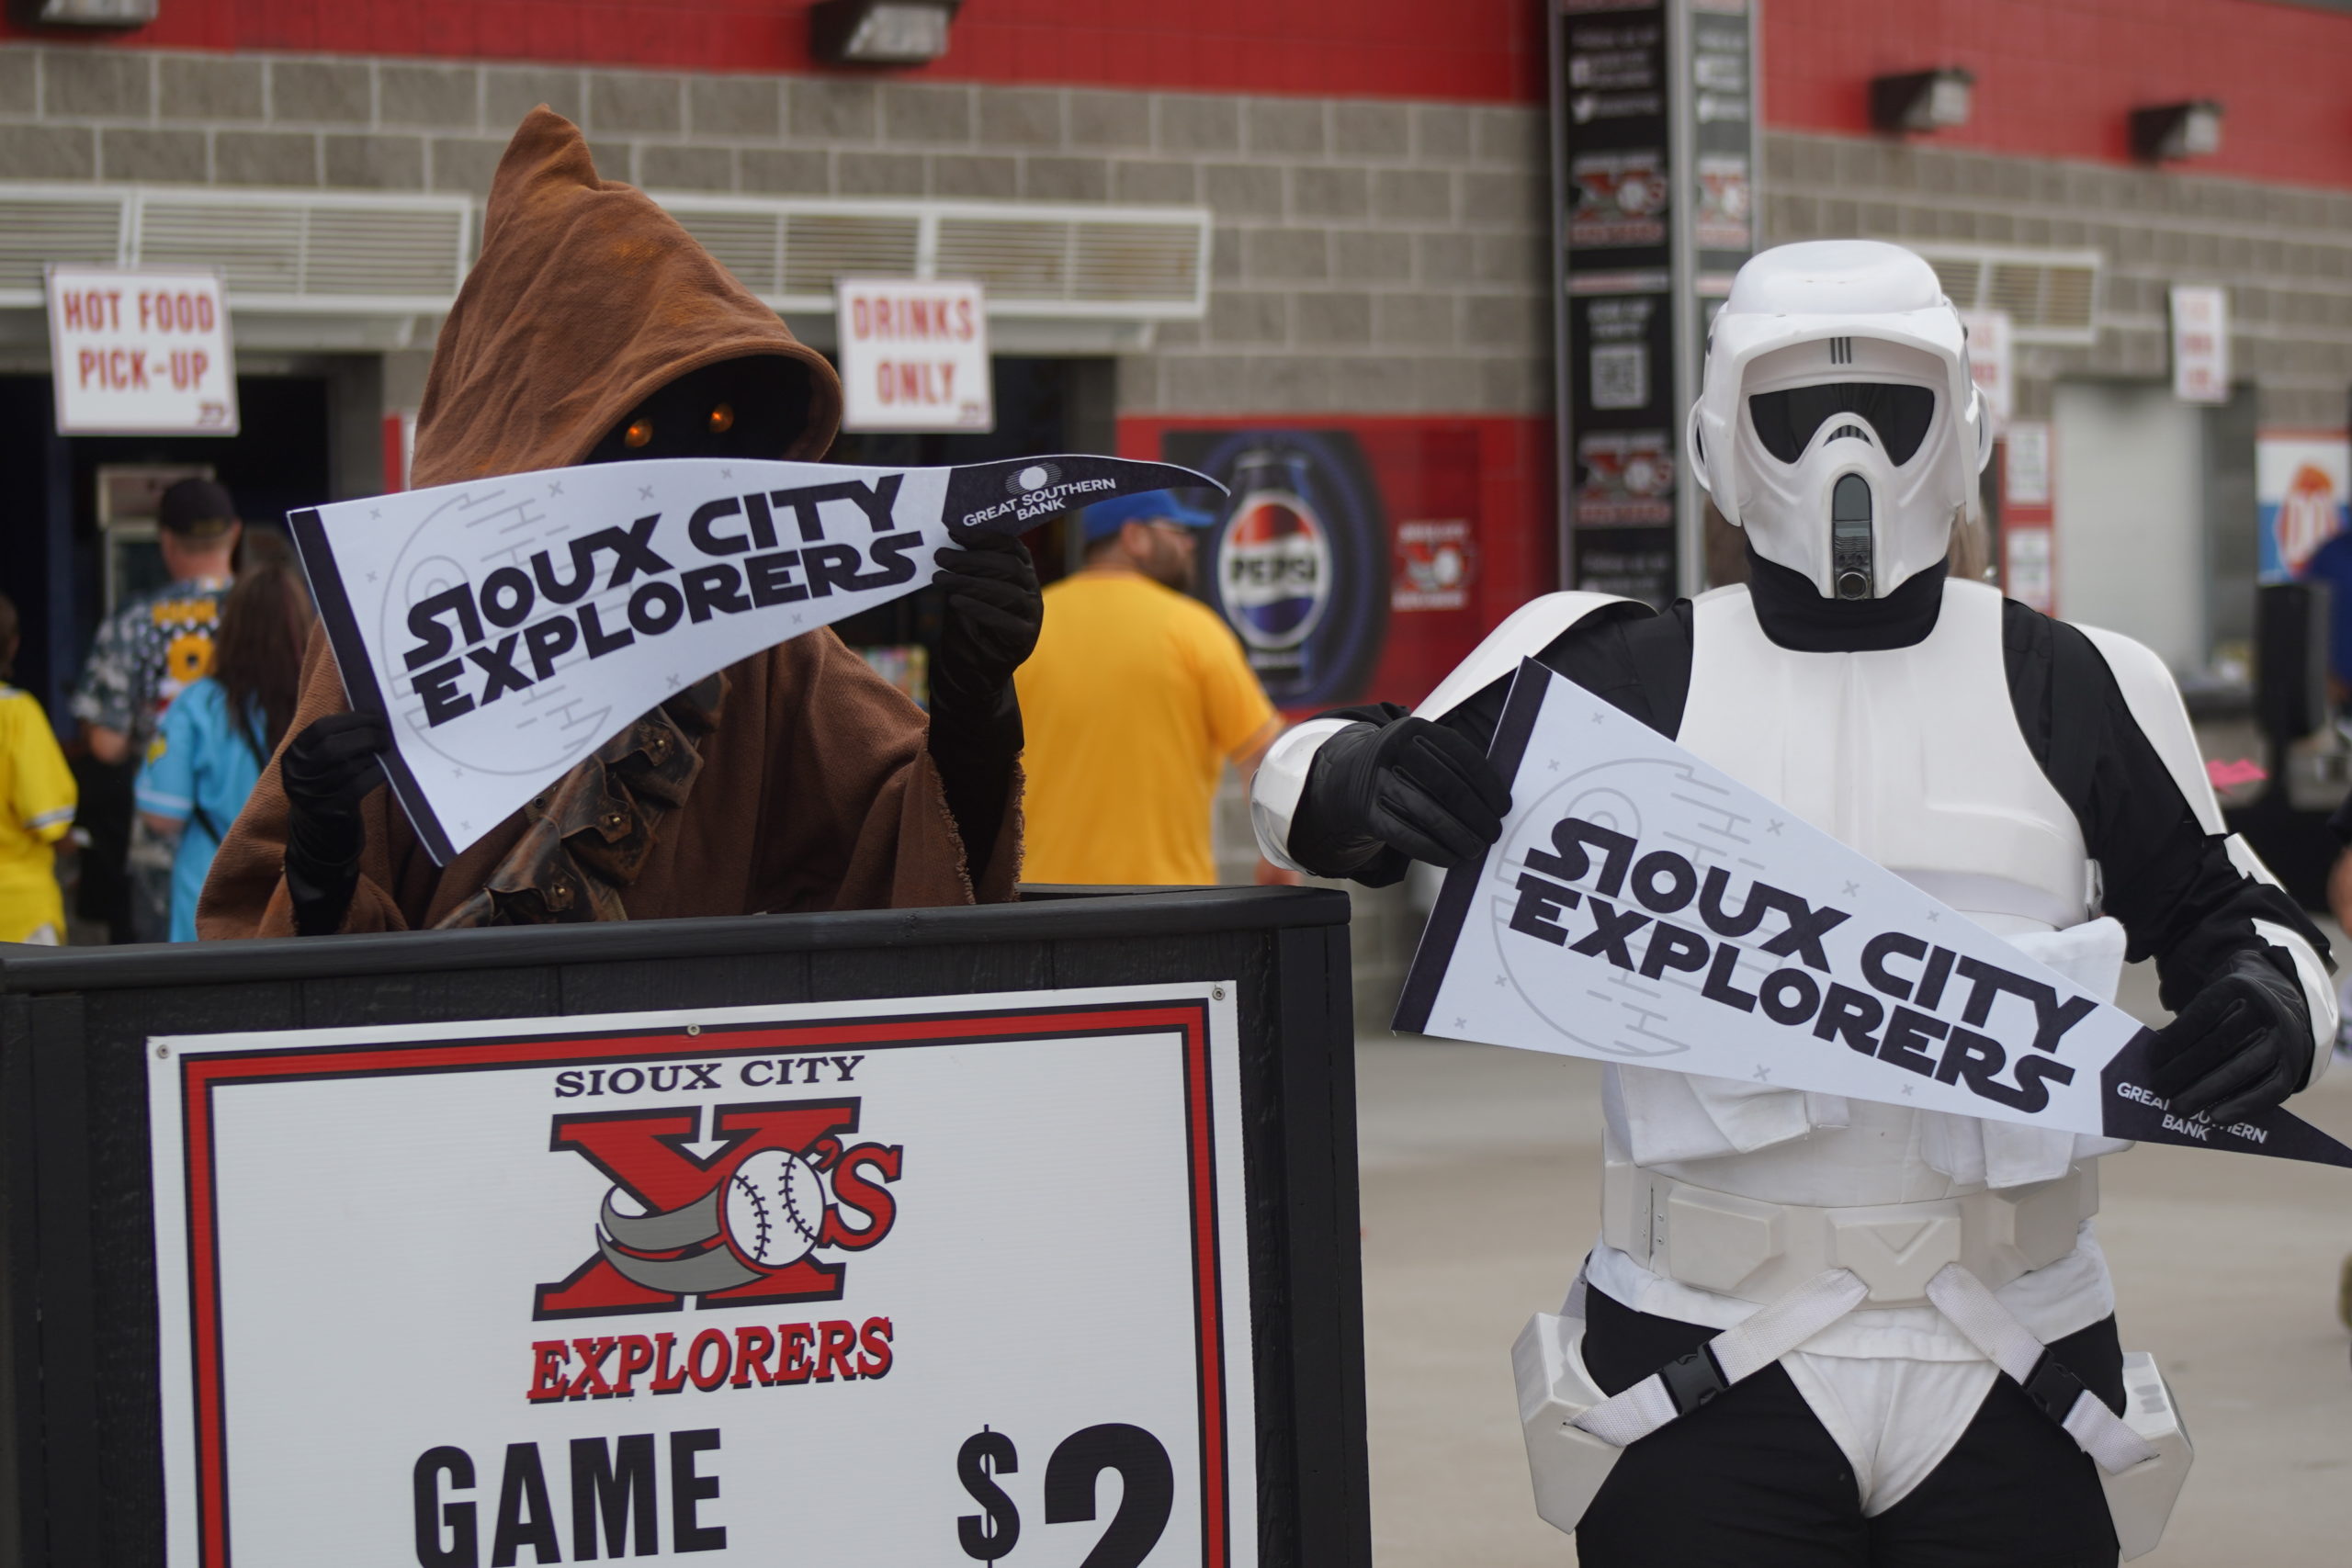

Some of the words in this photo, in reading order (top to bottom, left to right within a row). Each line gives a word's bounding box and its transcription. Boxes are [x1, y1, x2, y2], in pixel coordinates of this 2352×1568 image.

[62, 290, 122, 333] HOT
[139, 290, 215, 333] FOOD
[852, 296, 975, 342] DRINKS
[78, 348, 209, 390] PICK-UP
[876, 360, 956, 405] ONLY
[962, 498, 1019, 527] GREAT
[1021, 478, 1117, 506] SOUTHERN
[1017, 497, 1066, 522] BANK
[403, 513, 675, 672] SIOUX
[687, 473, 905, 557] CITY
[1229, 555, 1317, 586] PEPSI
[410, 530, 924, 728] EXPLORERS
[1523, 817, 1852, 975] SIOUX
[1860, 931, 2099, 1055] CITY
[1509, 871, 2076, 1114] EXPLORERS
[554, 1063, 723, 1098] SIOUX
[740, 1055, 865, 1087] CITY
[2161, 1113, 2211, 1142] BANK
[526, 1316, 895, 1404] EXPLORERS
[413, 1427, 728, 1567] GAME
